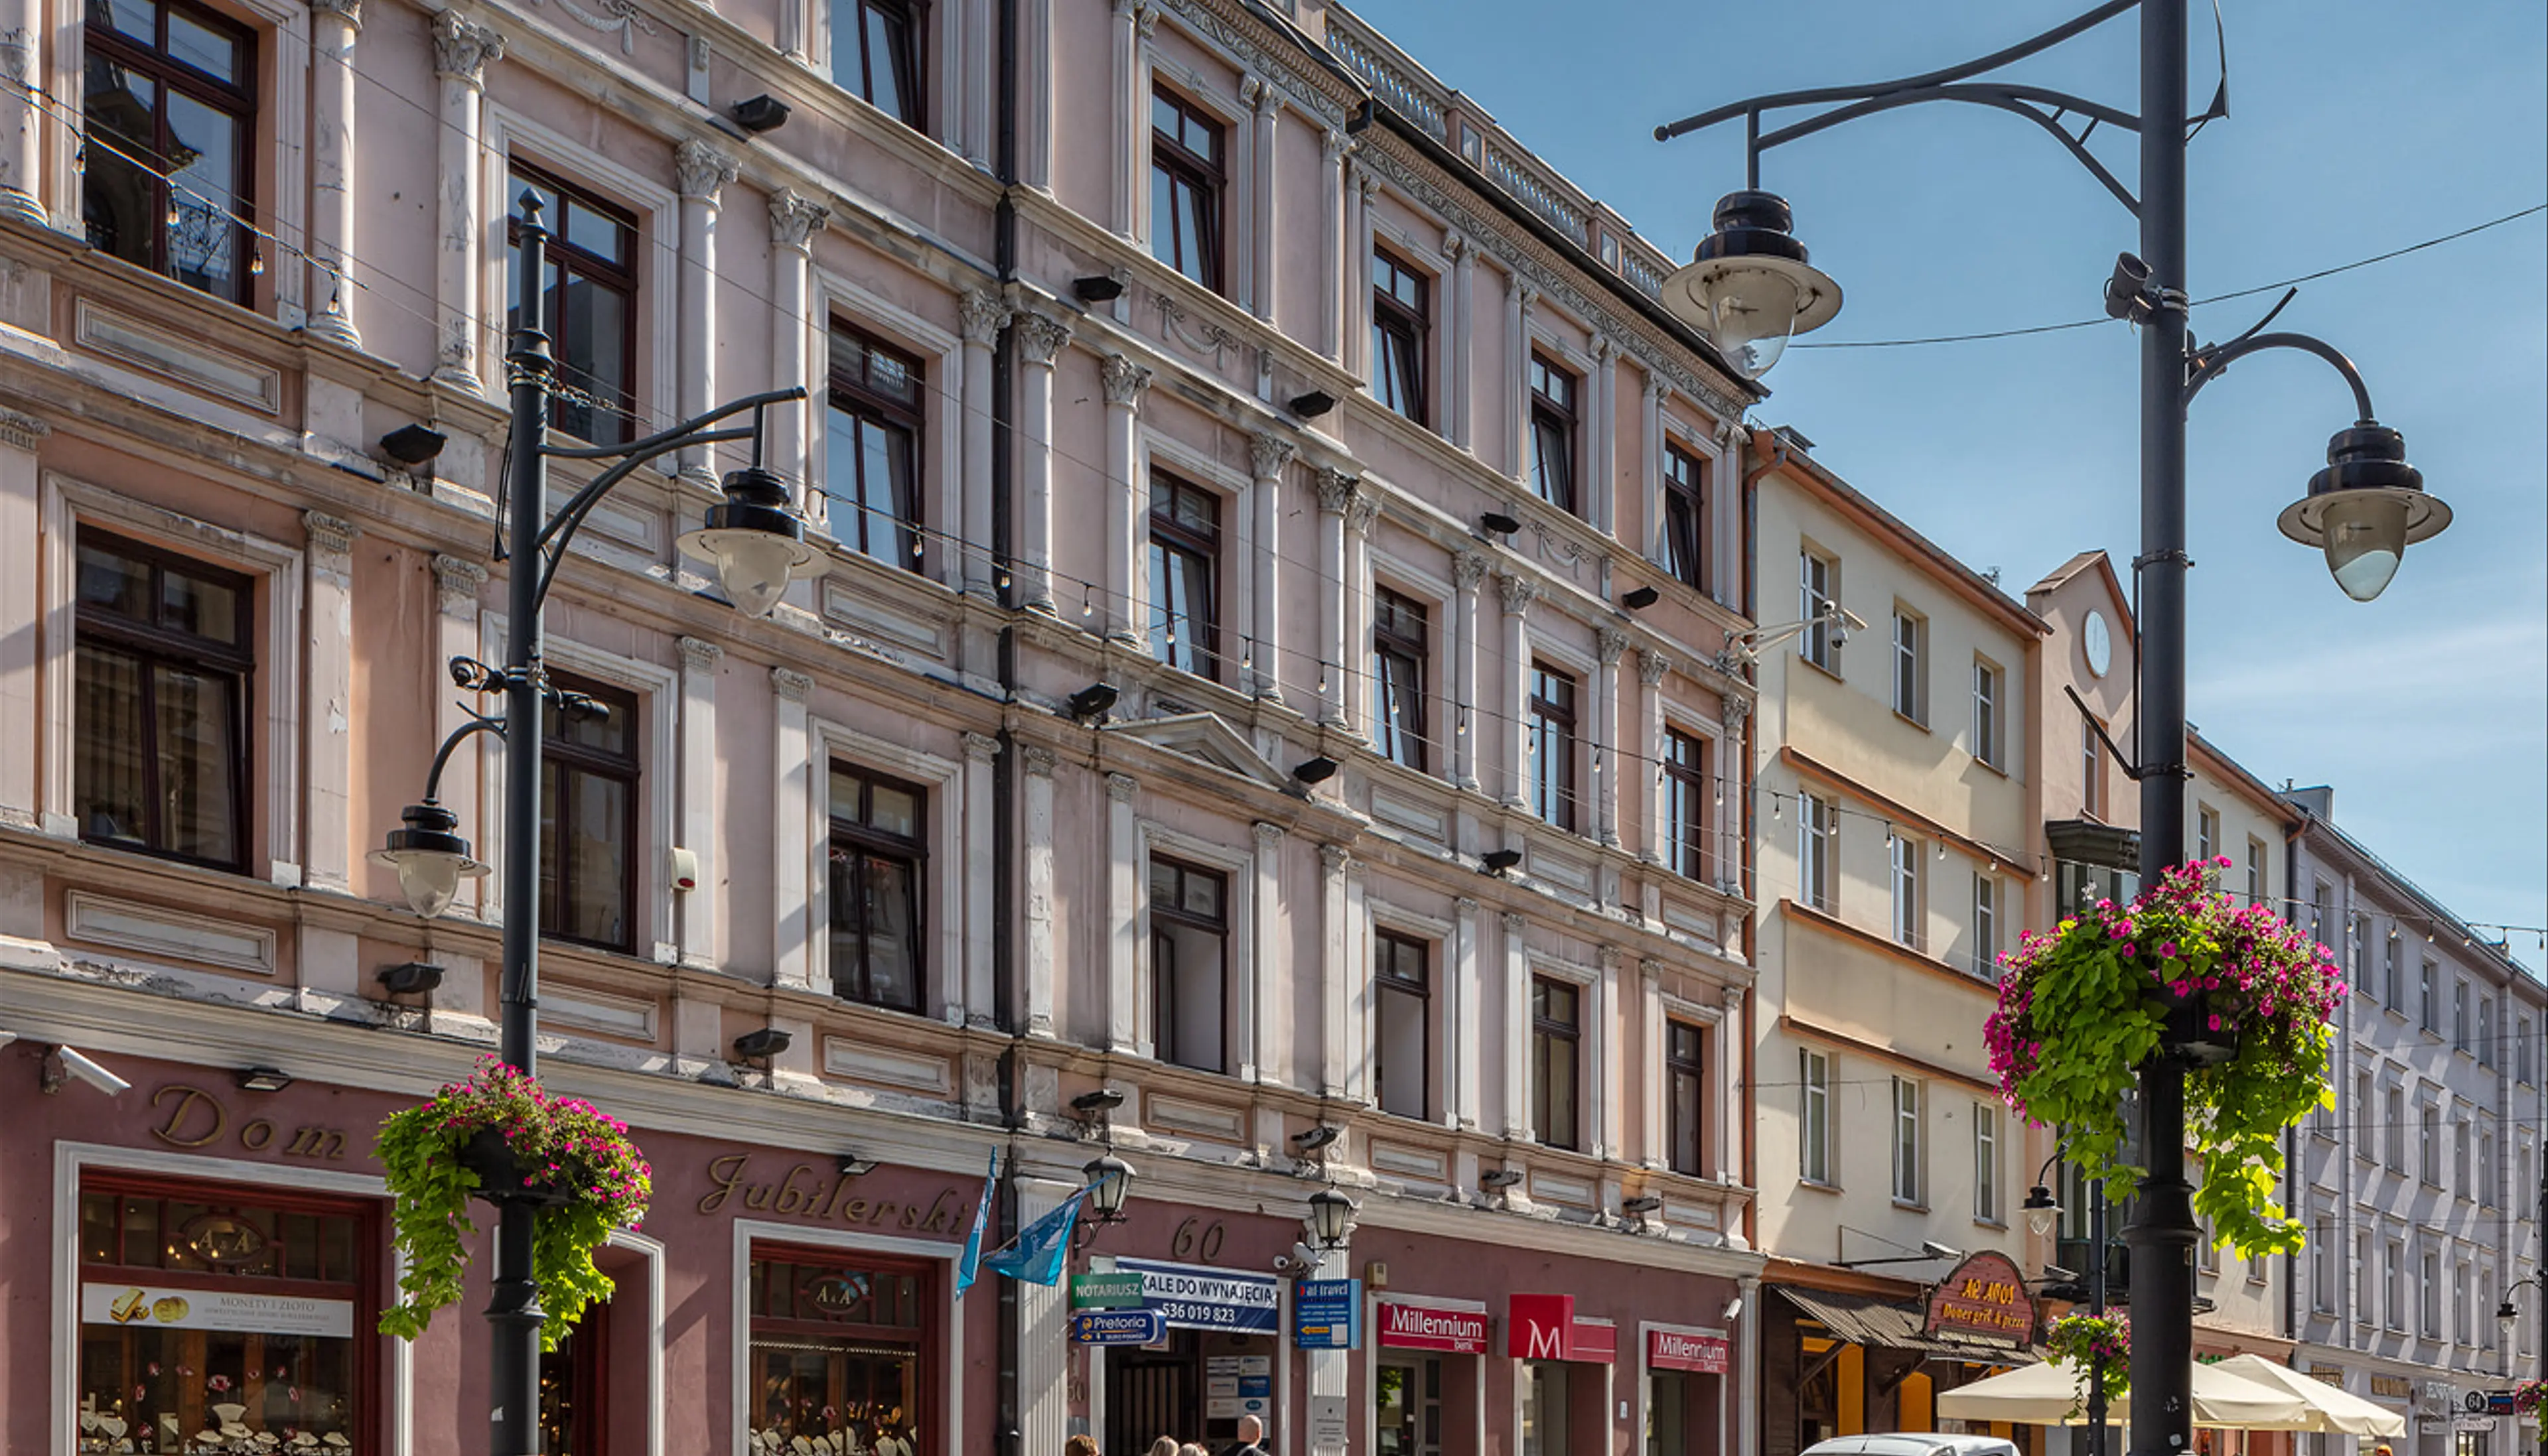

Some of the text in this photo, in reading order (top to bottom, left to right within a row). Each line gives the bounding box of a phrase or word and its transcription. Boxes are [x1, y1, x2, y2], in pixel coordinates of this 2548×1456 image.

[151, 1085, 348, 1159] Dom
[697, 1153, 969, 1234] Jubilerski
[1172, 1215, 1225, 1262] 60
[1076, 1284, 1139, 1297] NOTARIUSZ
[1176, 1279, 1196, 1295] DO
[1199, 1280, 1273, 1305] WYNAJĘCIA
[1094, 1315, 1146, 1329] Pretoria
[1162, 1302, 1235, 1323] 536 019 823
[1391, 1305, 1482, 1337] Millennium
[1527, 1318, 1561, 1358] M
[1659, 1331, 1725, 1361] Millennium
